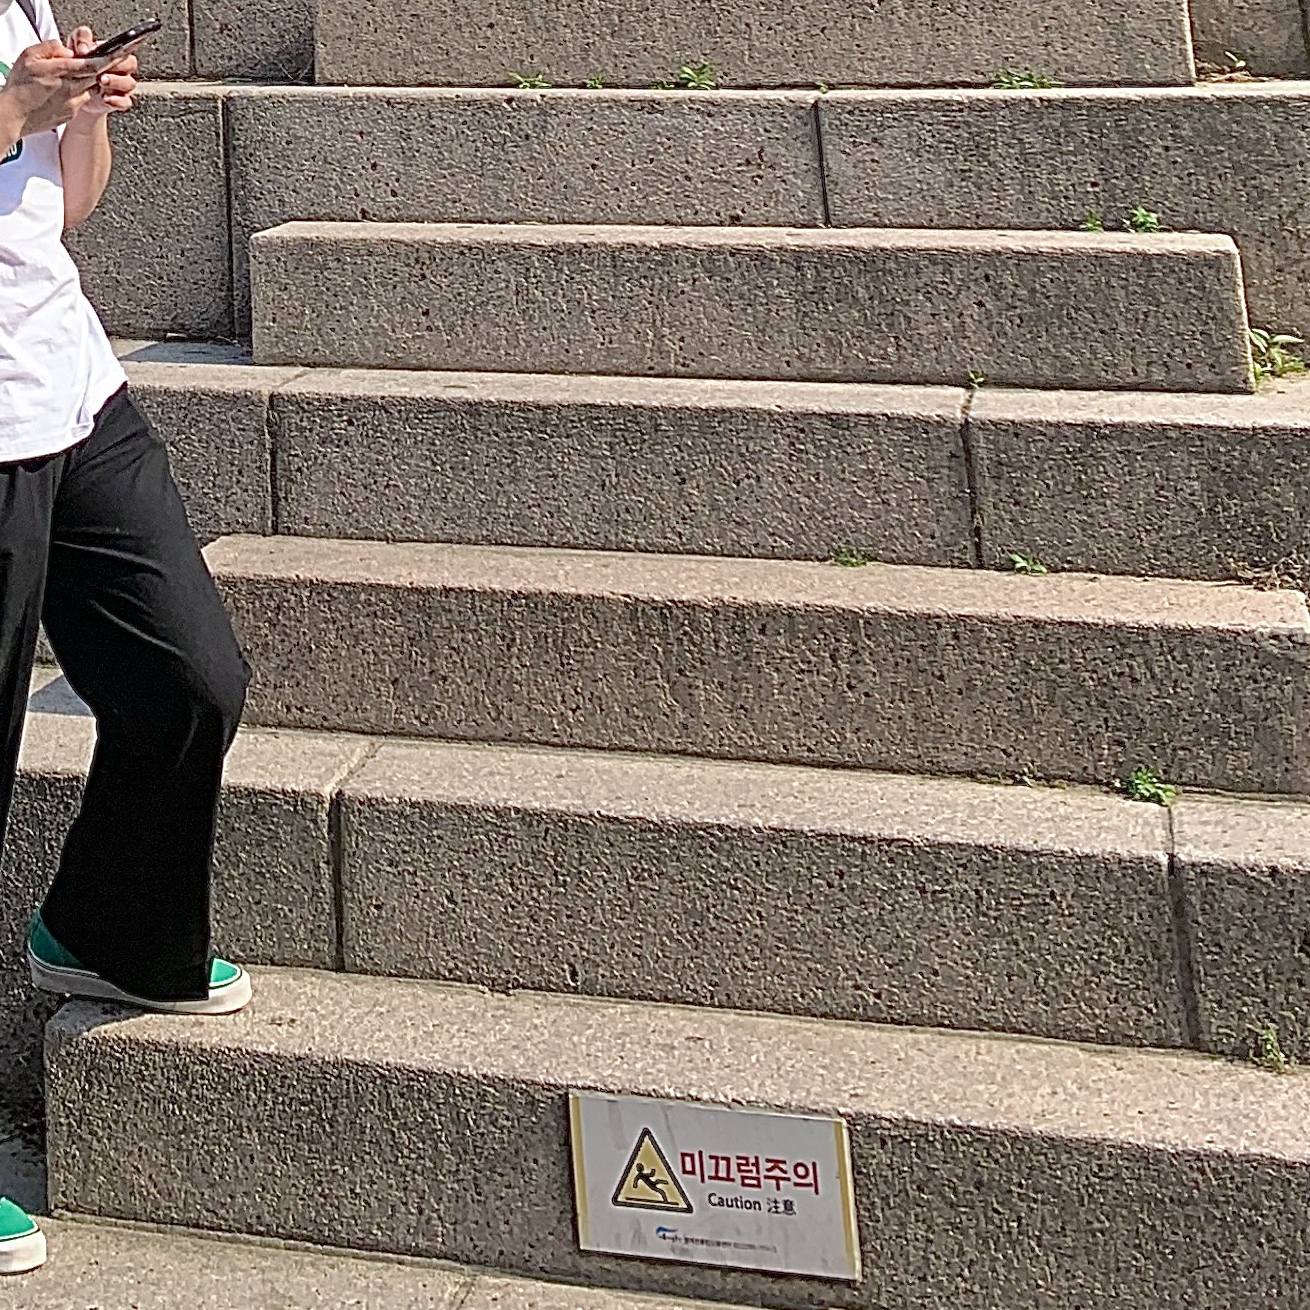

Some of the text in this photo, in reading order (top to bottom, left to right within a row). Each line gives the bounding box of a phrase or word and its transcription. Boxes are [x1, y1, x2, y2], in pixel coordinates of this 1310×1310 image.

[679, 1149, 819, 1195] 미끄럼주의
[707, 1192, 797, 1216] Caution 注意
